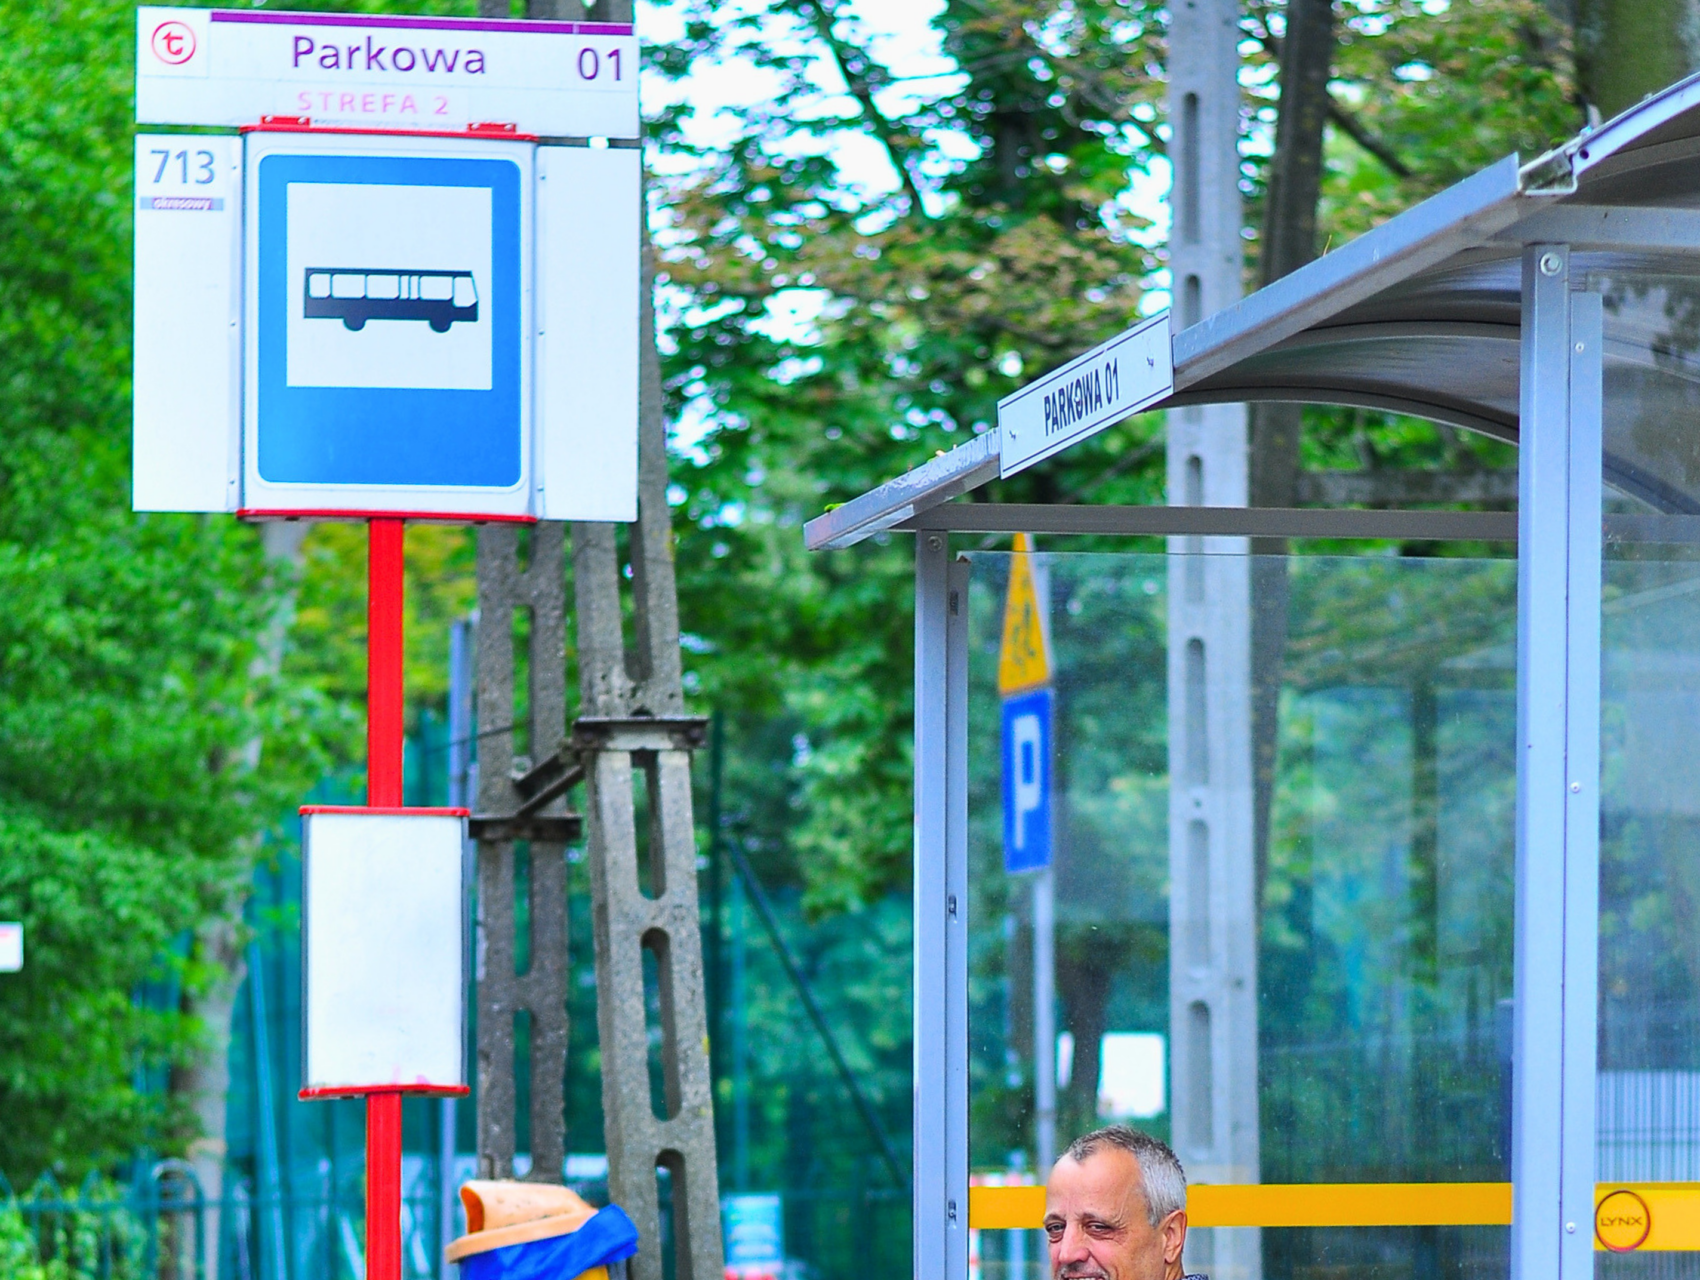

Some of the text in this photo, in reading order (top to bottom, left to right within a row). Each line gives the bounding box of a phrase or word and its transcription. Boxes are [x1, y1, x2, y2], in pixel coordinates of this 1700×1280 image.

[293, 36, 622, 81] Parkowa 01
[297, 91, 449, 115] STREFA 2
[151, 149, 215, 184] 713
[1043, 357, 1119, 437] PARKOWA 01
[1013, 715, 1041, 850] P
[1600, 1216, 1643, 1227] LYNX
